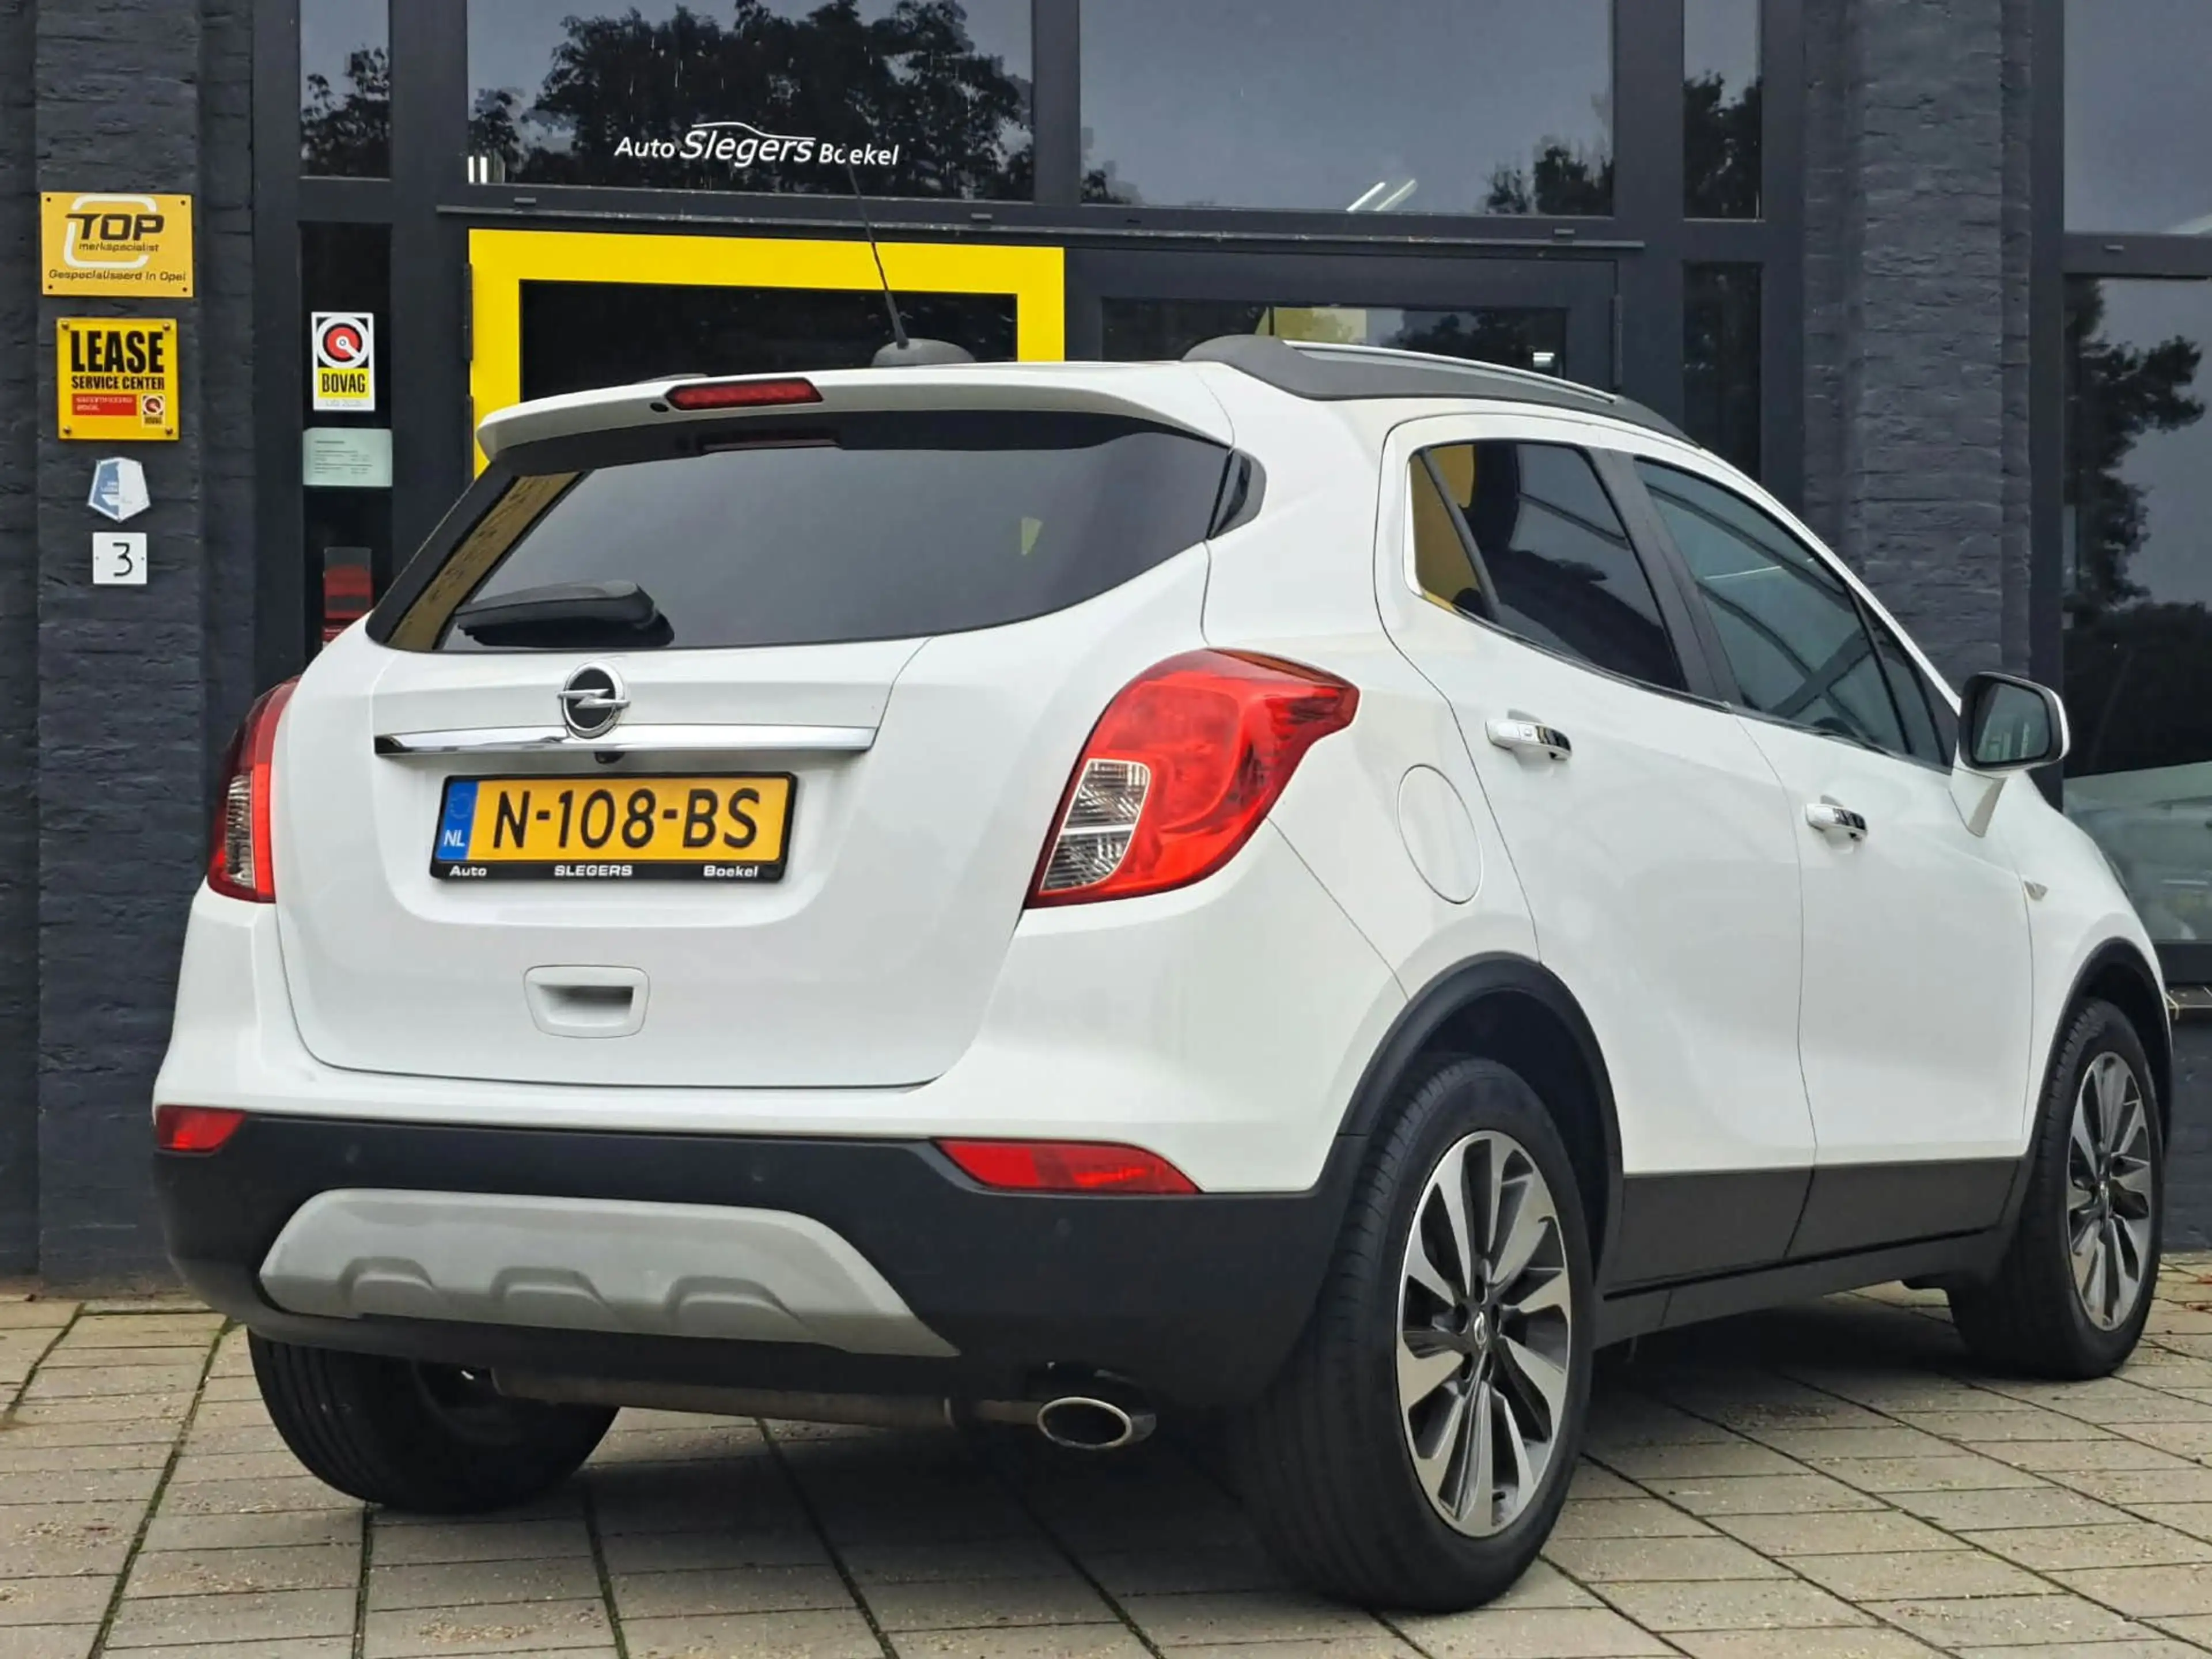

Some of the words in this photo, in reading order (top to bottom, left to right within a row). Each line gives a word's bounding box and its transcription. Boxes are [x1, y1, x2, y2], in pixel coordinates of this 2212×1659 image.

[614, 136, 675, 158] Auto
[680, 130, 816, 168] Slegers
[65, 213, 164, 241] TOP
[70, 330, 165, 374] LEASE
[71, 375, 119, 390] SERVICE
[122, 376, 165, 391] CENTER
[321, 373, 366, 393] BOVAG
[112, 541, 133, 578] 3
[492, 786, 761, 850] N-108-BS
[444, 830, 465, 847] NL
[449, 865, 488, 877] Auto
[554, 864, 633, 877] SLEGERS
[703, 865, 759, 878] Boekel
